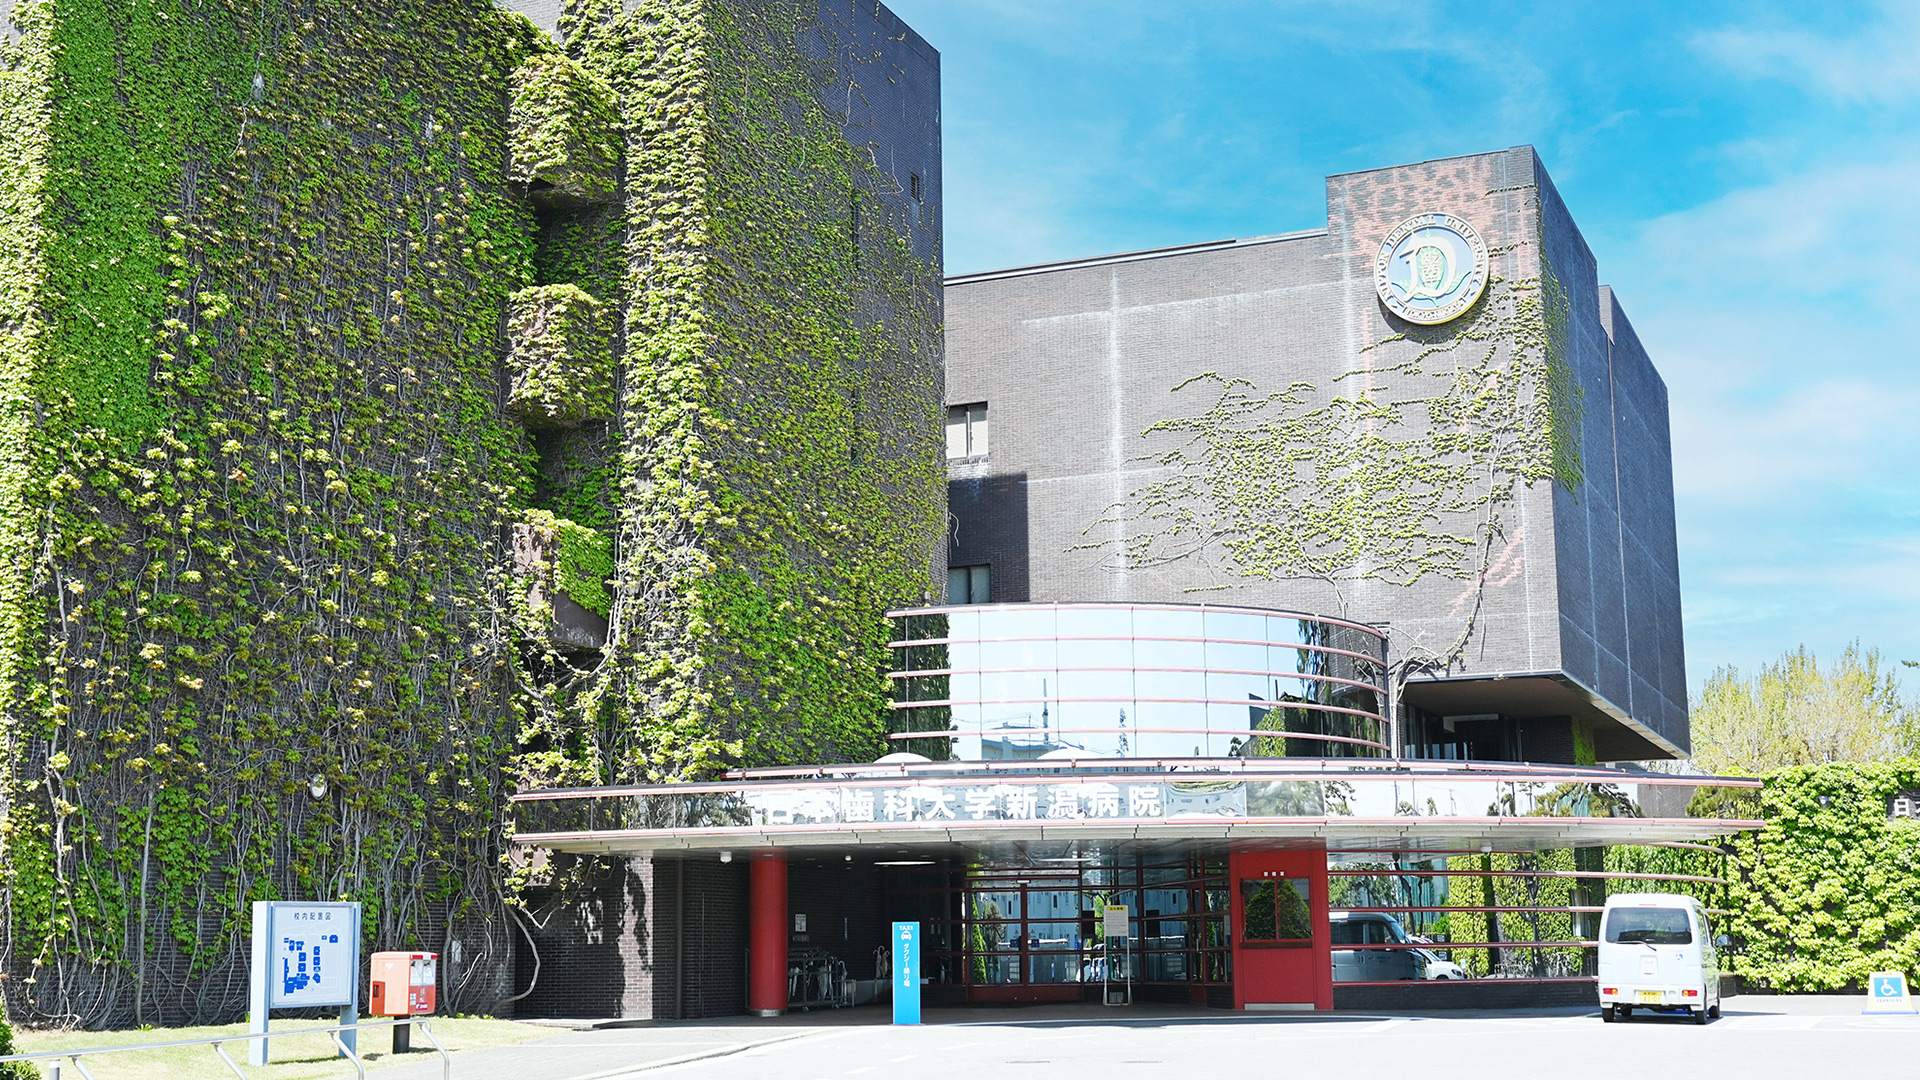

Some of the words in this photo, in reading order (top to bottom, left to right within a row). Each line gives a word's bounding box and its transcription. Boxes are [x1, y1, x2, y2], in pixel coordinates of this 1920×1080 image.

[1377, 251, 1395, 301] NIPPON
[1387, 215, 1436, 249] DENTAL
[1444, 217, 1484, 286] UNIVERSITY
[293, 912, 331, 921] 校内配置図
